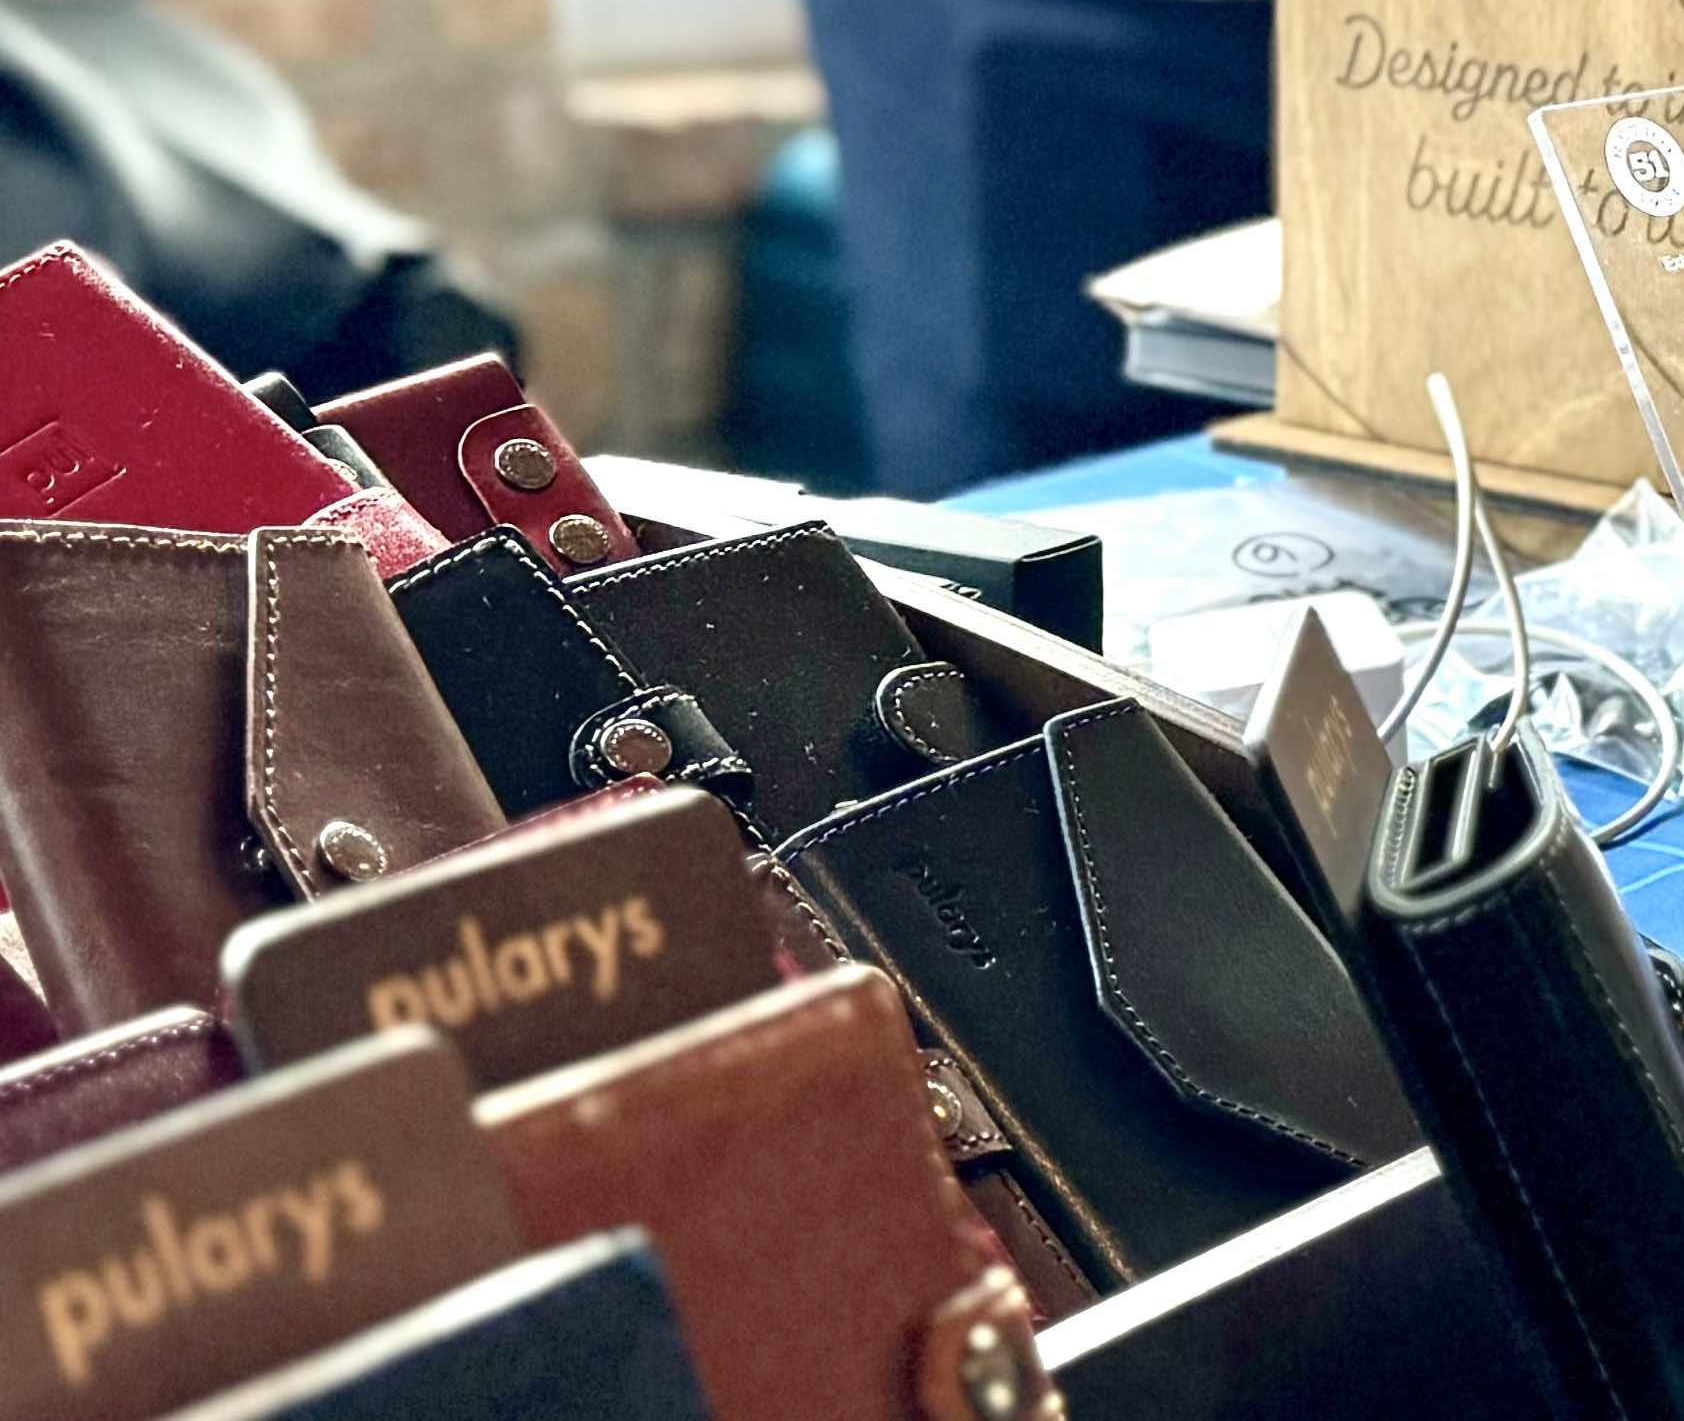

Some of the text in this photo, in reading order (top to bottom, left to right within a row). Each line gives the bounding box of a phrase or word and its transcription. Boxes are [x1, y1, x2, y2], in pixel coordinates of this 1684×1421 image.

[1336, 12, 1588, 122] Designed
[1406, 134, 1557, 229] built
[367, 893, 668, 1031] pularys
[38, 1157, 387, 1388] pularys
